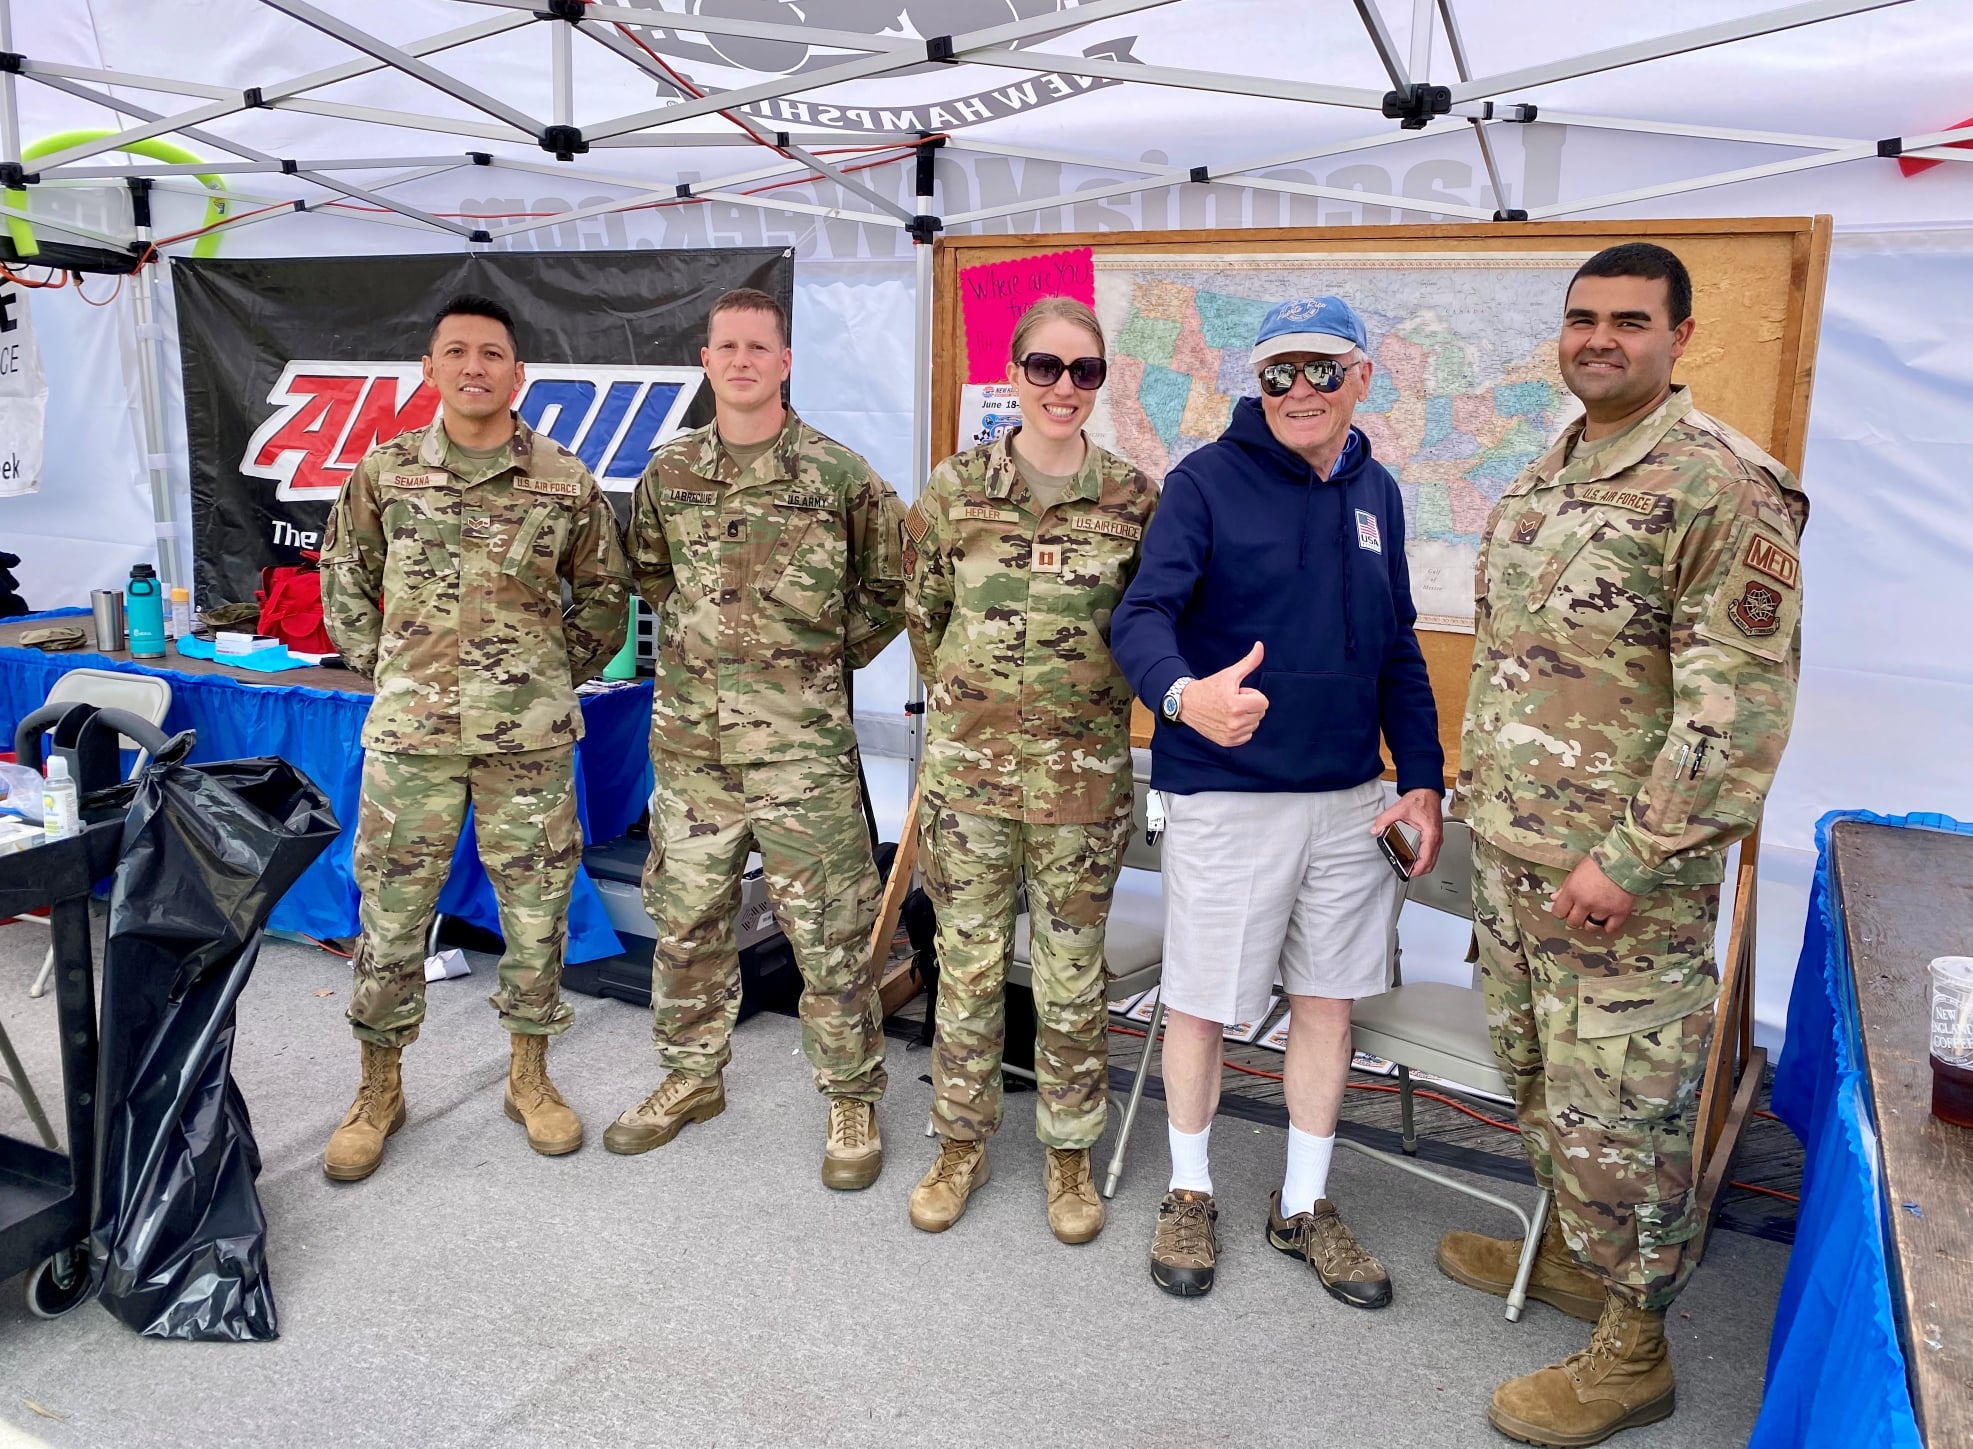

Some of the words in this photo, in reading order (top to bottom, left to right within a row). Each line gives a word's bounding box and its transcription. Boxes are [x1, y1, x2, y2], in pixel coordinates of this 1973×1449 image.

[968, 268, 1020, 299] Where
[1028, 271, 1053, 292] are
[981, 400, 1002, 409] June
[1006, 400, 1021, 409] 18-
[252, 372, 698, 491] AMOIL
[0, 453, 20, 479] ek
[394, 475, 430, 486] SEMANA
[517, 479, 532, 488] U.S.
[534, 481, 548, 491] AIR
[550, 483, 577, 494] FORCE
[802, 496, 828, 508] ARMY
[1582, 487, 1600, 500] U.S.
[1600, 490, 1619, 502] AIR
[1616, 492, 1652, 511] FORCE
[965, 508, 1001, 520] HEPLER
[271, 520, 317, 550] The
[1076, 517, 1092, 530] U.S.
[1094, 519, 1110, 533] AIR
[1110, 522, 1140, 539] FORCE
[1360, 533, 1379, 547] USA
[1749, 538, 1794, 580] MED
[1427, 568, 1441, 576] Gulf
